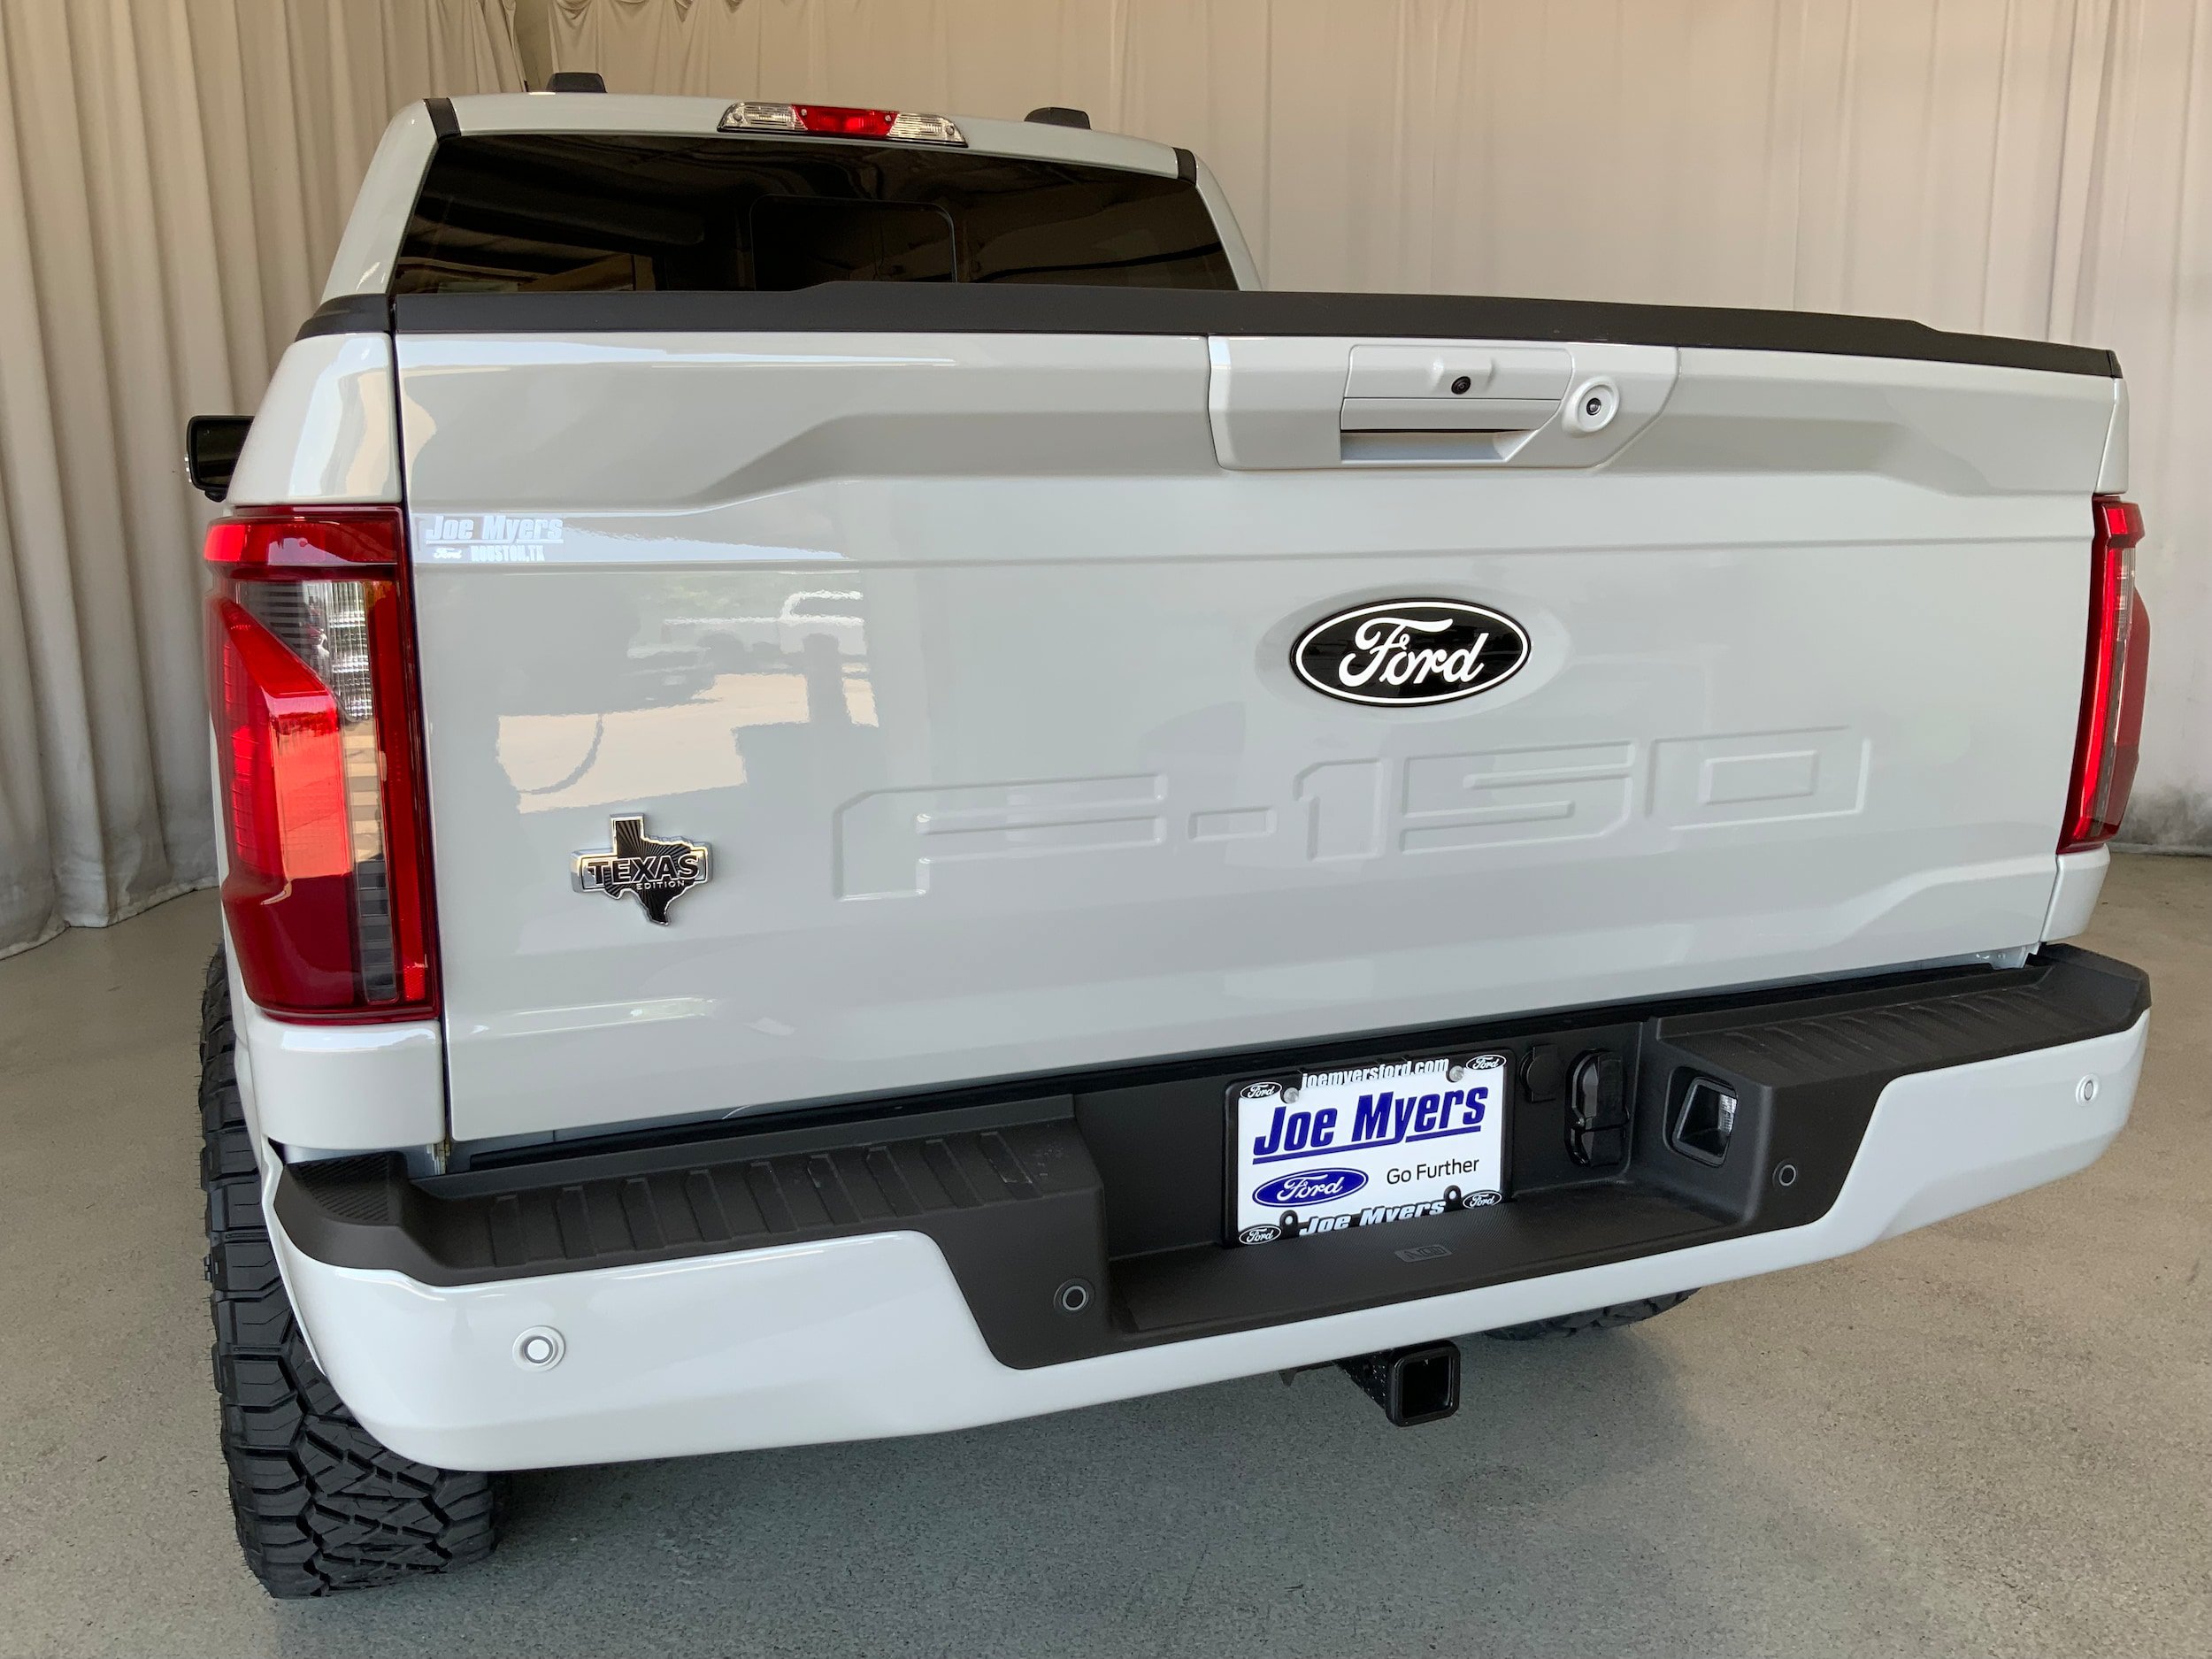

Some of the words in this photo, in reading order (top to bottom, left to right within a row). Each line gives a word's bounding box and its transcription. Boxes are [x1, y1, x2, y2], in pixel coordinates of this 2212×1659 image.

[426, 516, 474, 540] Joe
[482, 516, 564, 543] Myers
[434, 548, 462, 559] Ford
[1338, 617, 1489, 687] Ford
[833, 726, 1872, 902] F-150
[588, 856, 700, 885] TEXAS
[636, 879, 685, 890] EDITION
[1301, 1058, 1449, 1090] joemyersford.com
[1472, 1056, 1500, 1069] Ford
[1247, 1084, 1275, 1097] Ford
[1253, 1106, 1338, 1156] Joe
[1351, 1087, 1489, 1143] Myers
[1386, 1167, 1411, 1184] Go
[1417, 1157, 1479, 1180] Further
[1276, 1174, 1345, 1201] Ford
[1469, 1194, 1495, 1206] Ford
[1299, 1216, 1351, 1236] Joe
[1359, 1200, 1447, 1226] Myers
[1246, 1227, 1274, 1242] Ford
